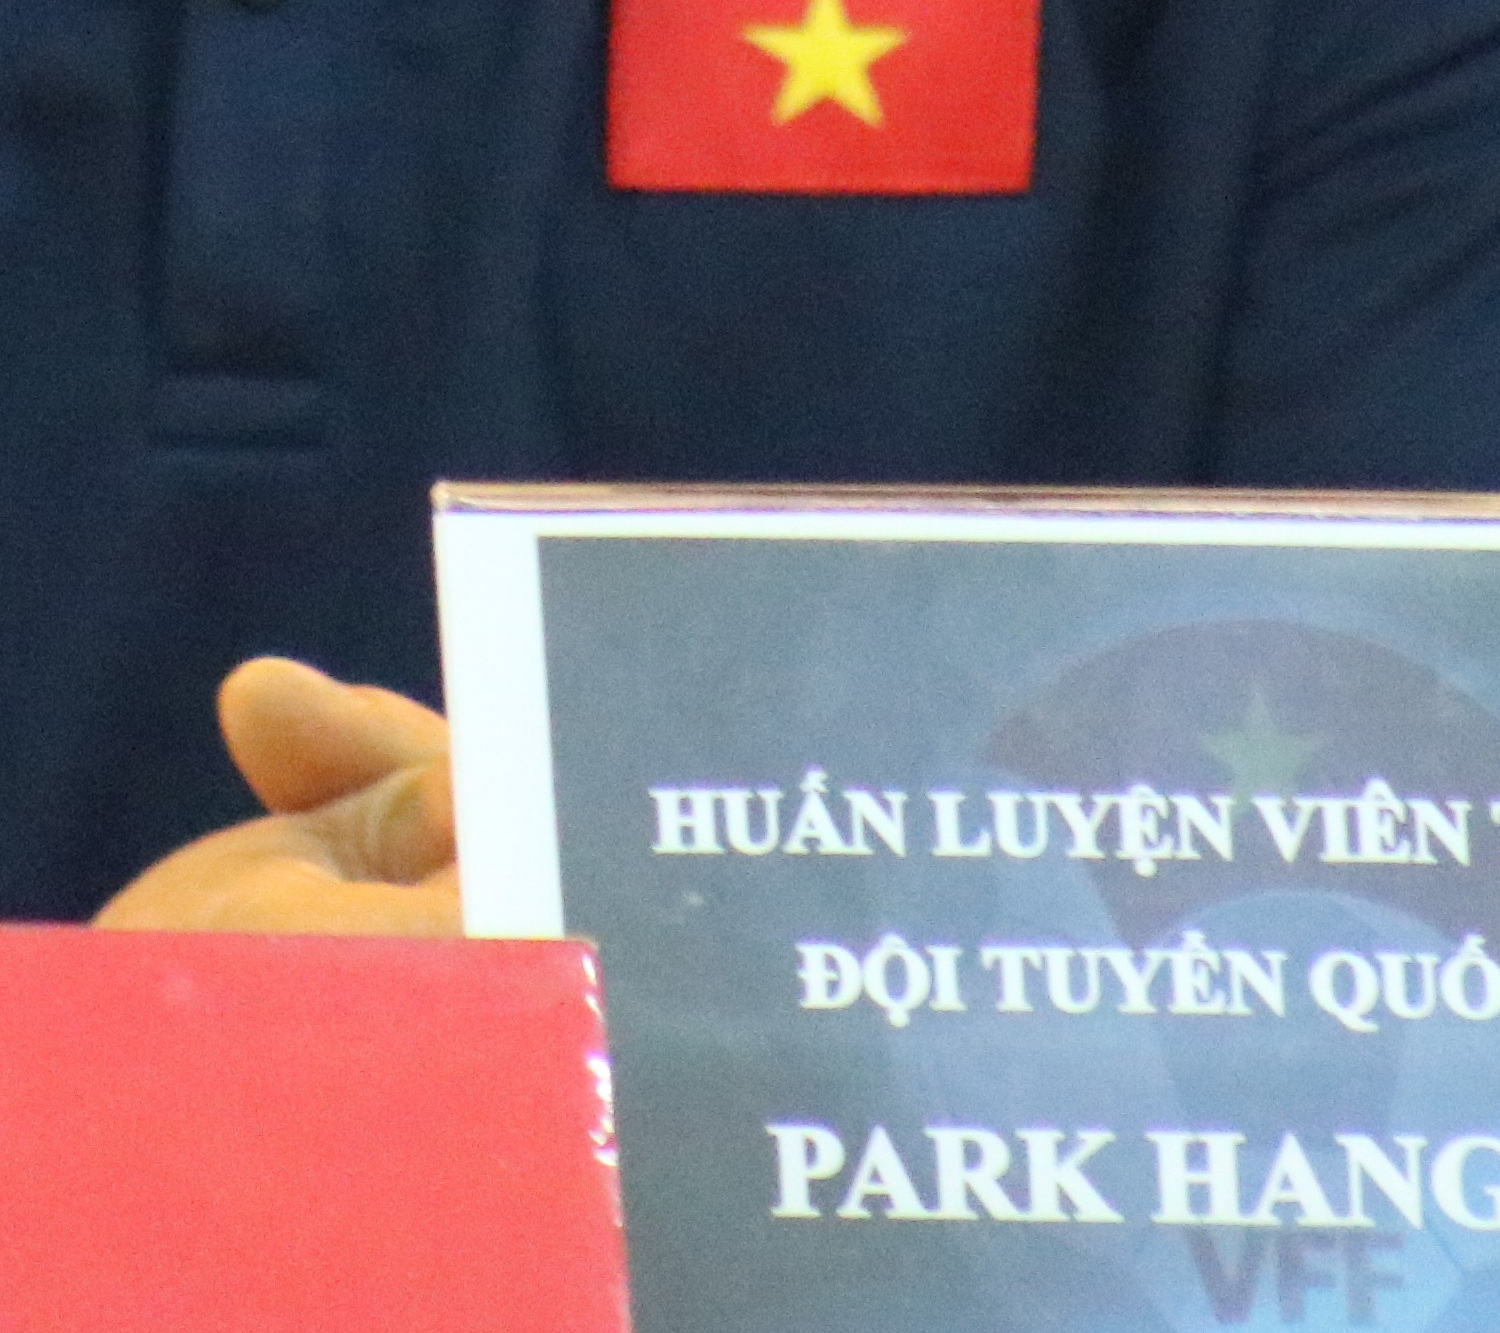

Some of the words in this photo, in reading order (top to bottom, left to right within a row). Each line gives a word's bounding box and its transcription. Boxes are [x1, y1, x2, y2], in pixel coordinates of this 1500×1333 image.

[648, 768, 908, 859] HUẤN
[925, 782, 1236, 879] LUYỆN
[1253, 776, 1473, 867] VIÊN
[795, 932, 967, 1029] ĐỘI
[980, 930, 1289, 1019] TUYỂN
[766, 1123, 1126, 1225] PARK
